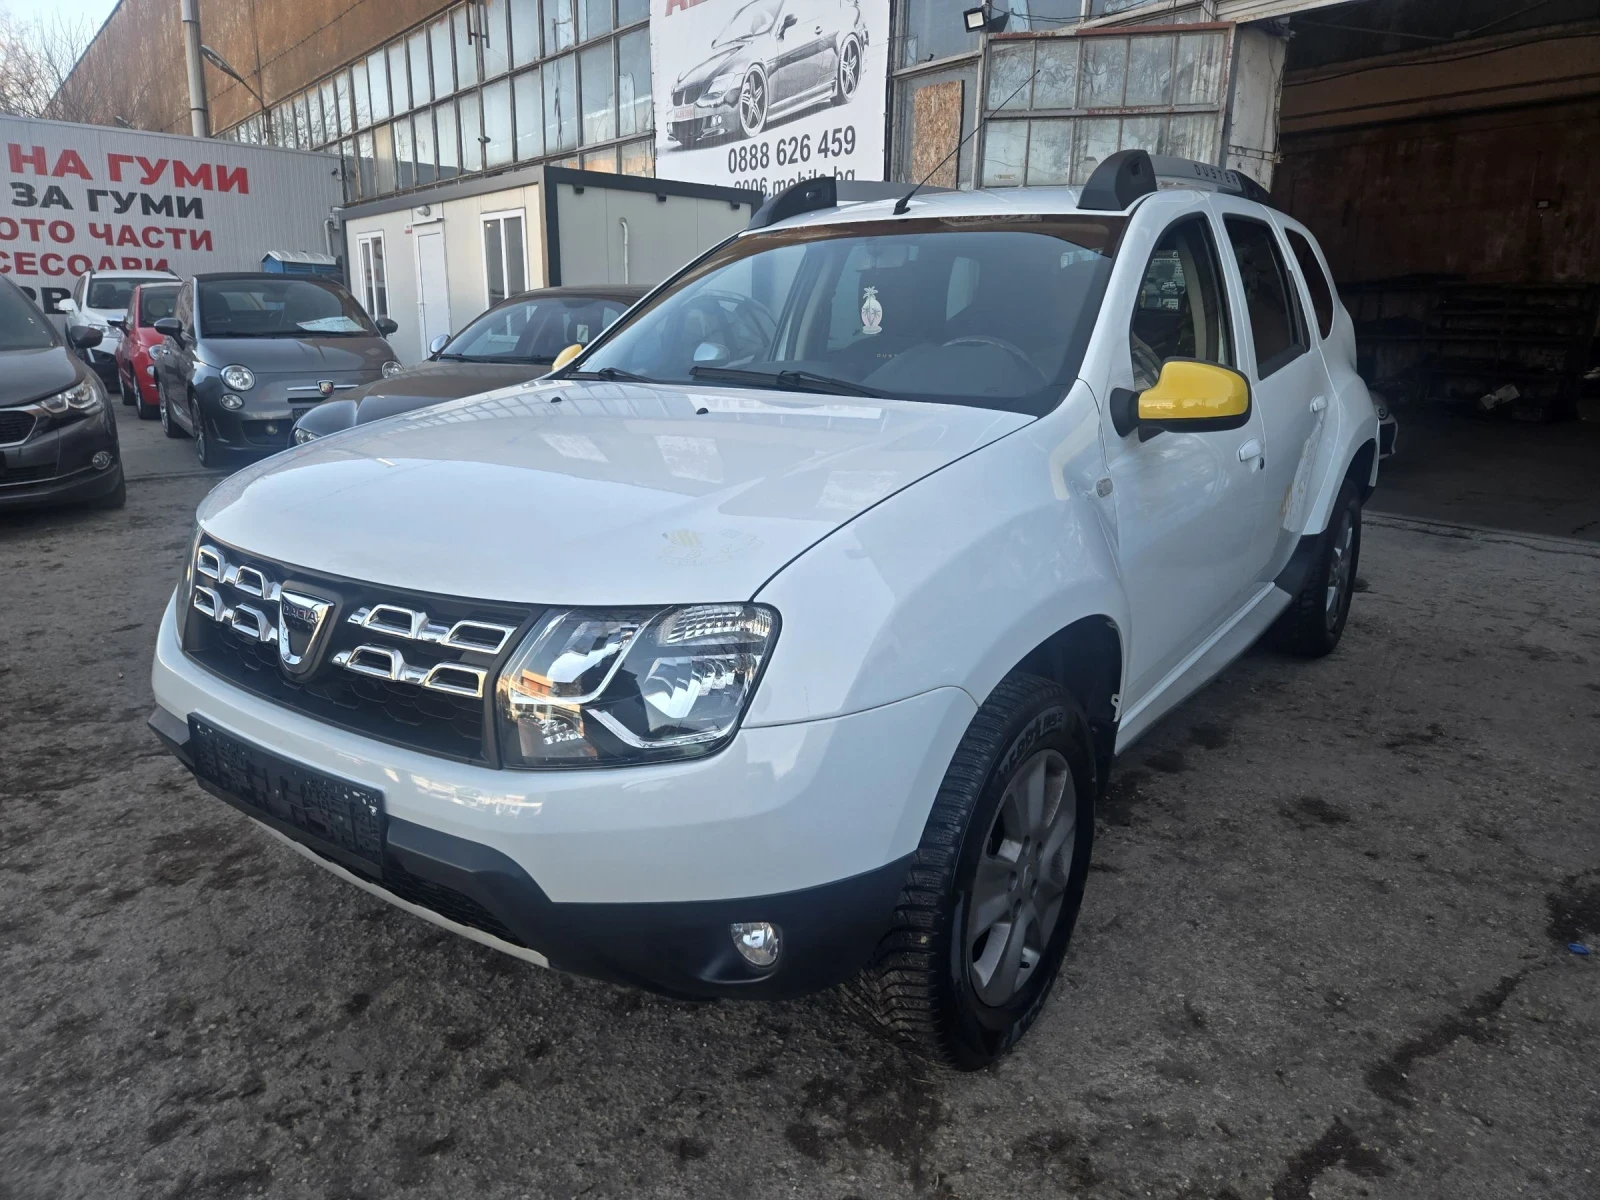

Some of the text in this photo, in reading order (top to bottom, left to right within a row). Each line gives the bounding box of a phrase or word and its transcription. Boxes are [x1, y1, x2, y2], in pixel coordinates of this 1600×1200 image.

[728, 125, 856, 173] 0888 626 459
[8, 143, 249, 194] НА ГУМИ
[1194, 164, 1238, 185] DUSTER
[10, 182, 204, 219] ЗА ГУМИ
[89, 222, 213, 252] ЧАСТИ
[283, 603, 318, 623] DACIA
